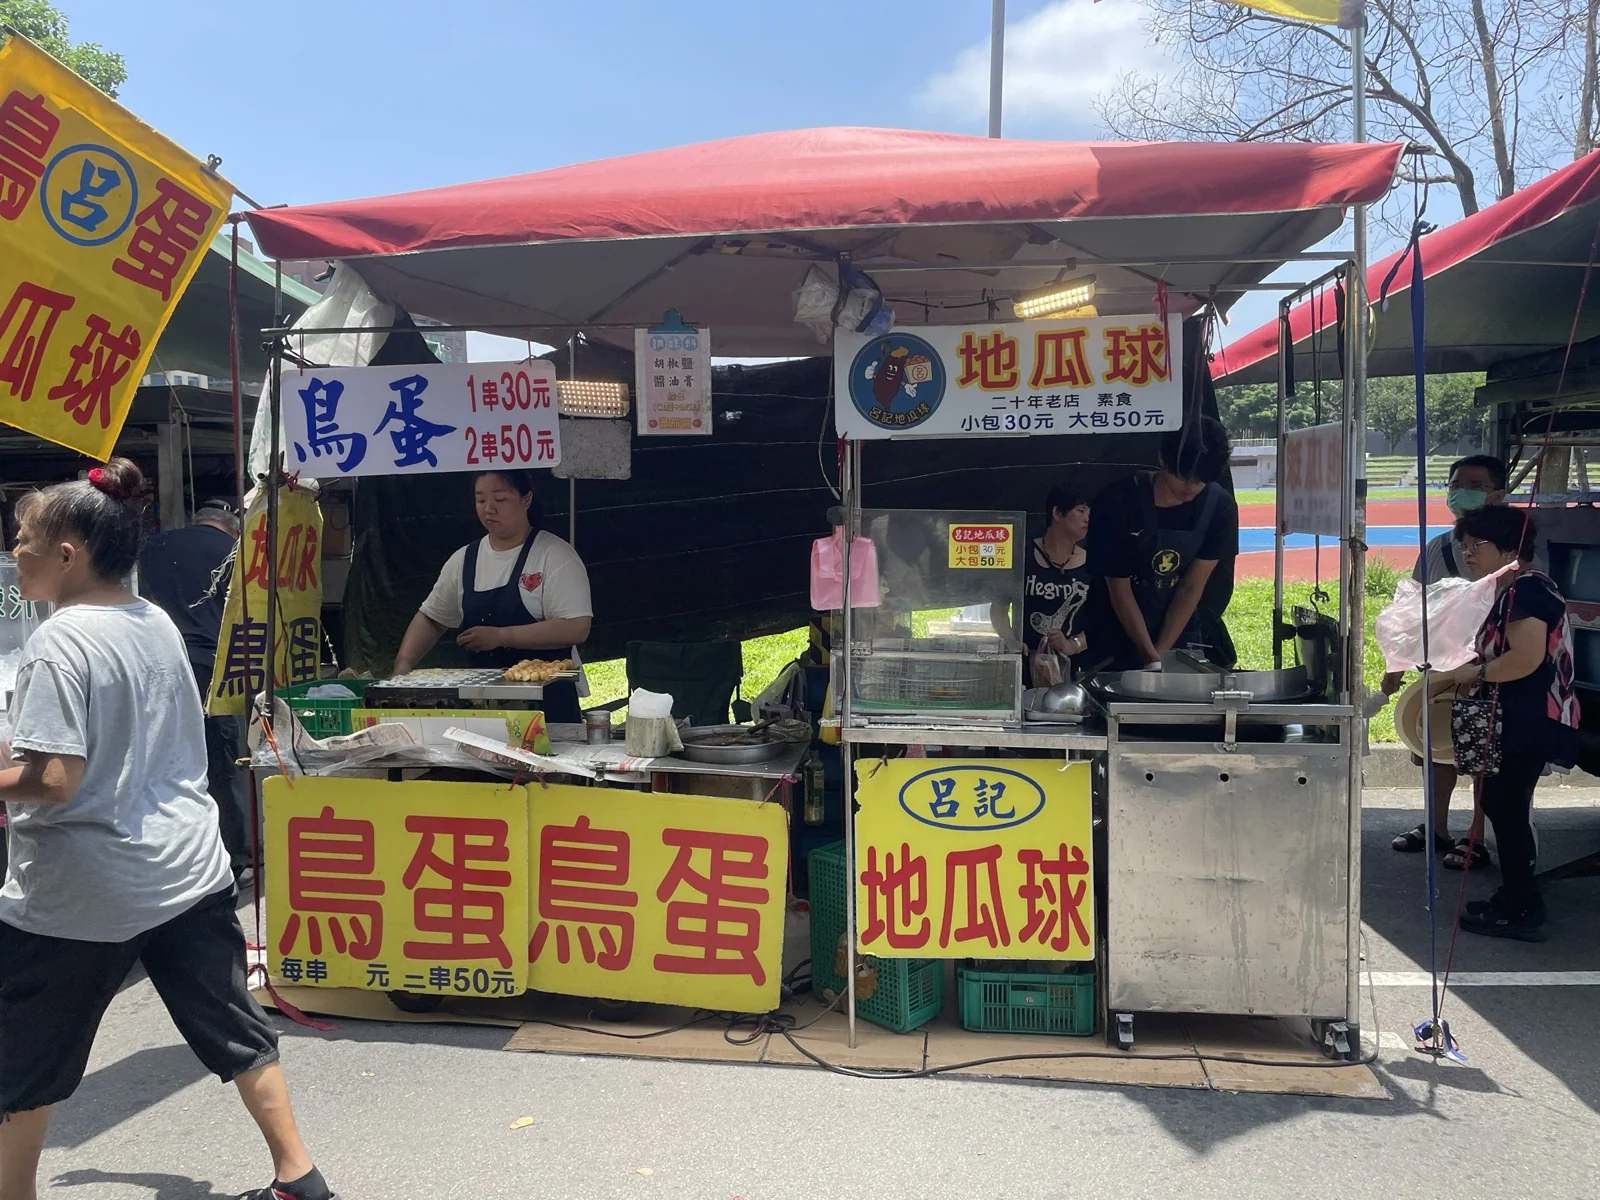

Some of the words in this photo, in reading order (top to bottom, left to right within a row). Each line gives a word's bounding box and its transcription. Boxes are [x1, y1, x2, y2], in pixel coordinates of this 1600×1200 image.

[653, 357, 693, 370] 胡椒鹽
[956, 322, 1170, 392] 地瓜球
[653, 375, 694, 388] 醬油膏
[869, 402, 930, 425] 呂記地瓜球
[991, 394, 1080, 410] 二十年老店
[1097, 392, 1133, 407] 素食
[293, 373, 457, 472] 鳥蛋
[466, 371, 551, 413] 1串30元
[960, 413, 1054, 432] 小包30元
[1069, 409, 1164, 429] 大包50元
[465, 423, 555, 465] 2串50元
[955, 529, 1006, 541] 呂記地瓜球
[955, 545, 1006, 555] 小包30元
[955, 556, 1006, 567] 大包50元
[928, 777, 1016, 819] 呂記
[278, 806, 514, 969] 鳥蛋
[860, 842, 1090, 953] 地瓜球
[528, 815, 769, 987] 鳥蛋
[403, 966, 516, 995] 二串50元
